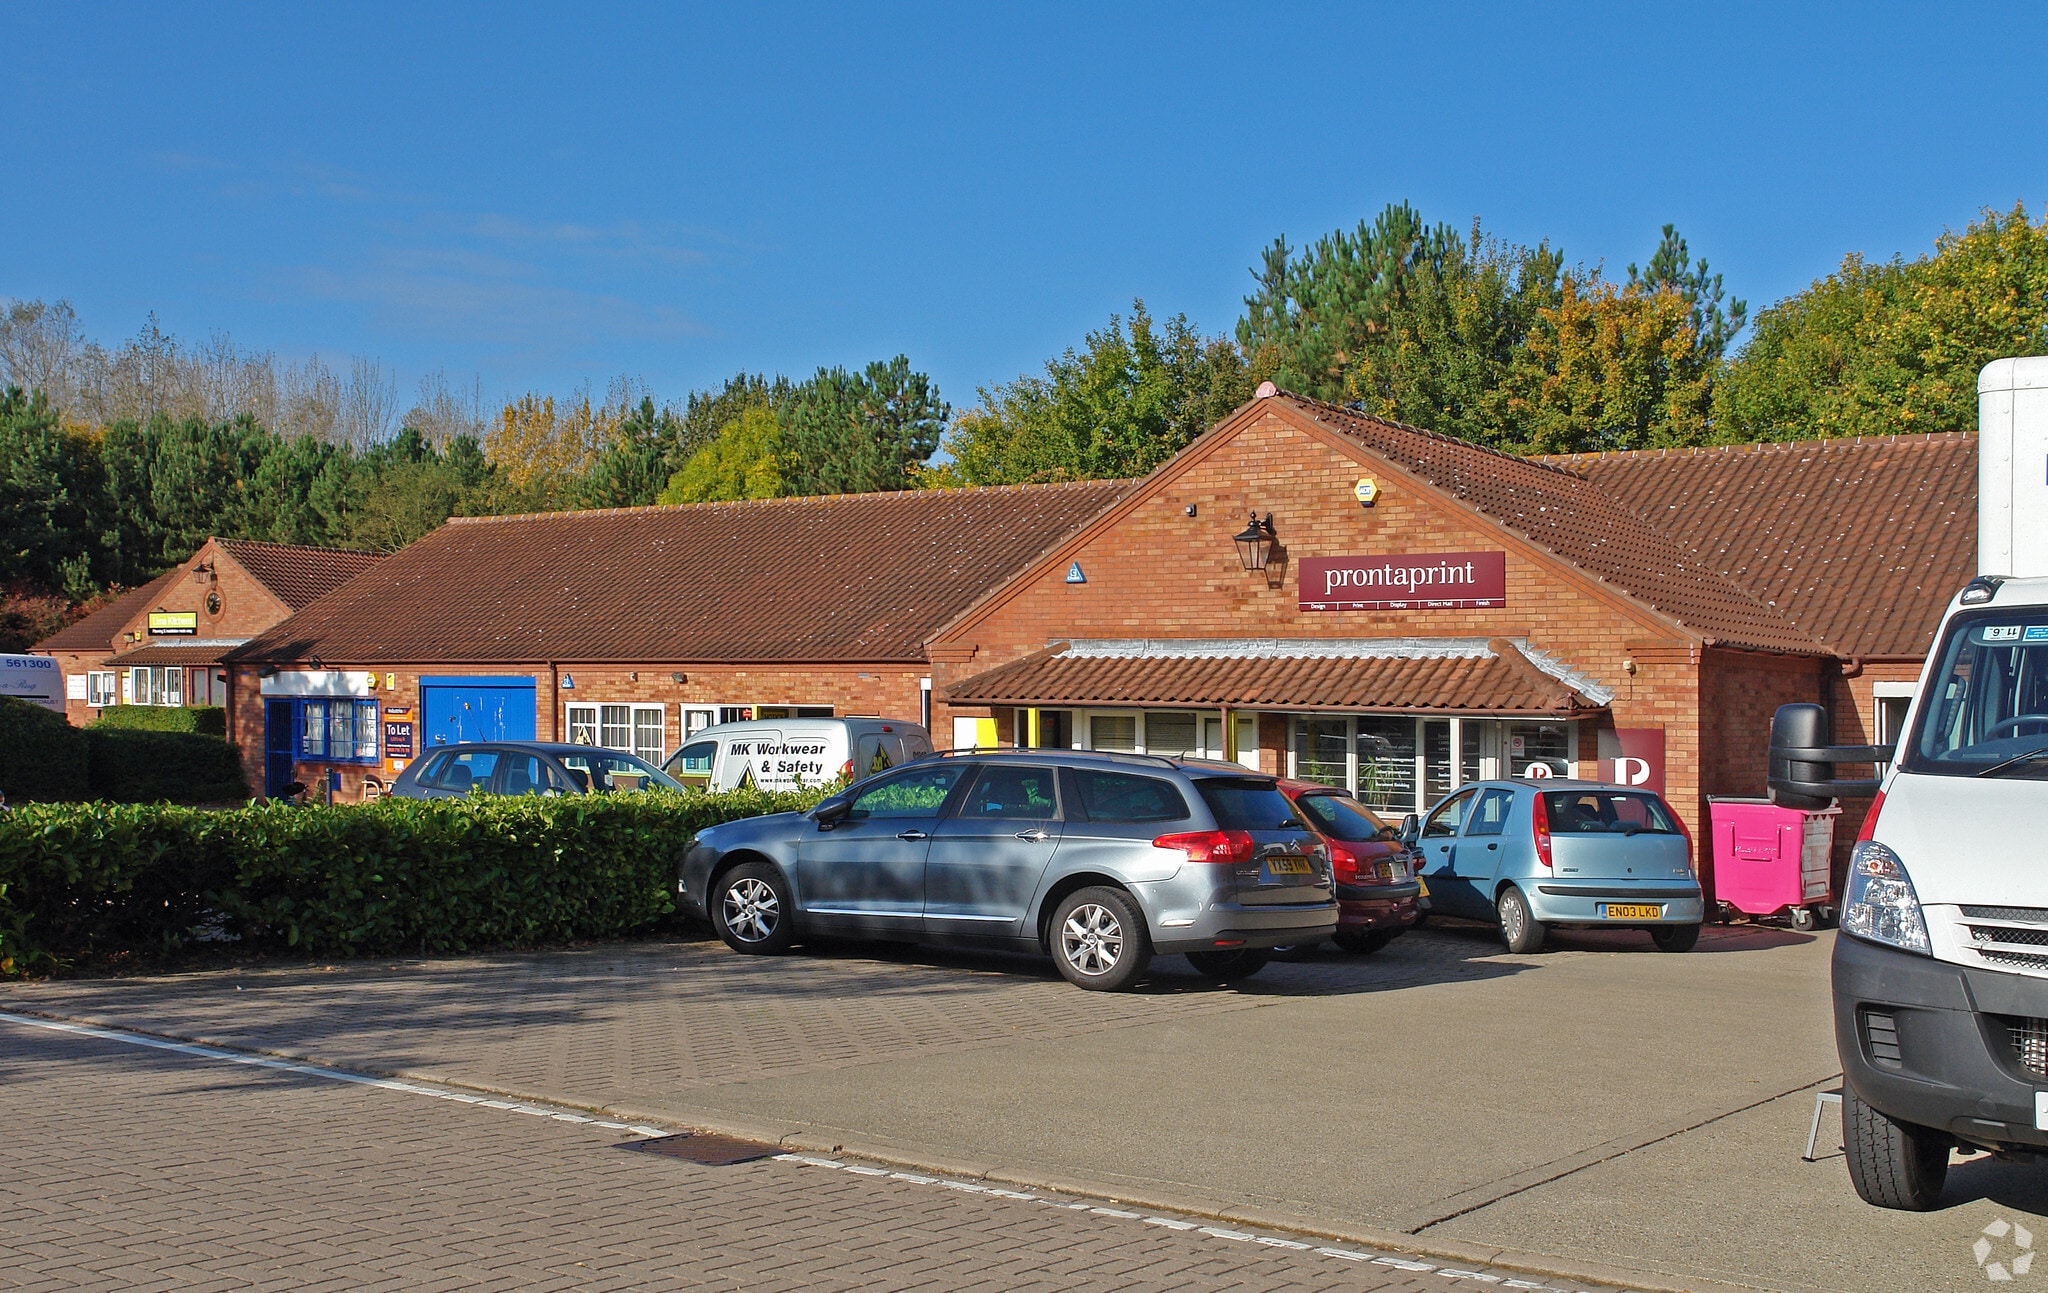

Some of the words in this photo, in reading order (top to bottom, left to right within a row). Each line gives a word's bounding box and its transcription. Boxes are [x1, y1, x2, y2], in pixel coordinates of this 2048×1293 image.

[1324, 560, 1475, 595] prontaprint
[1310, 602, 1326, 610] Design
[6, 659, 51, 668] 561300
[386, 724, 396, 736] To
[396, 724, 410, 736] Let
[730, 743, 751, 756] MK
[757, 743, 826, 755] Workwear
[761, 760, 770, 773] &
[777, 760, 823, 775] Safety
[1611, 757, 1650, 786] P
[1608, 906, 1636, 917] EN03
[1638, 907, 1658, 918] LKD
